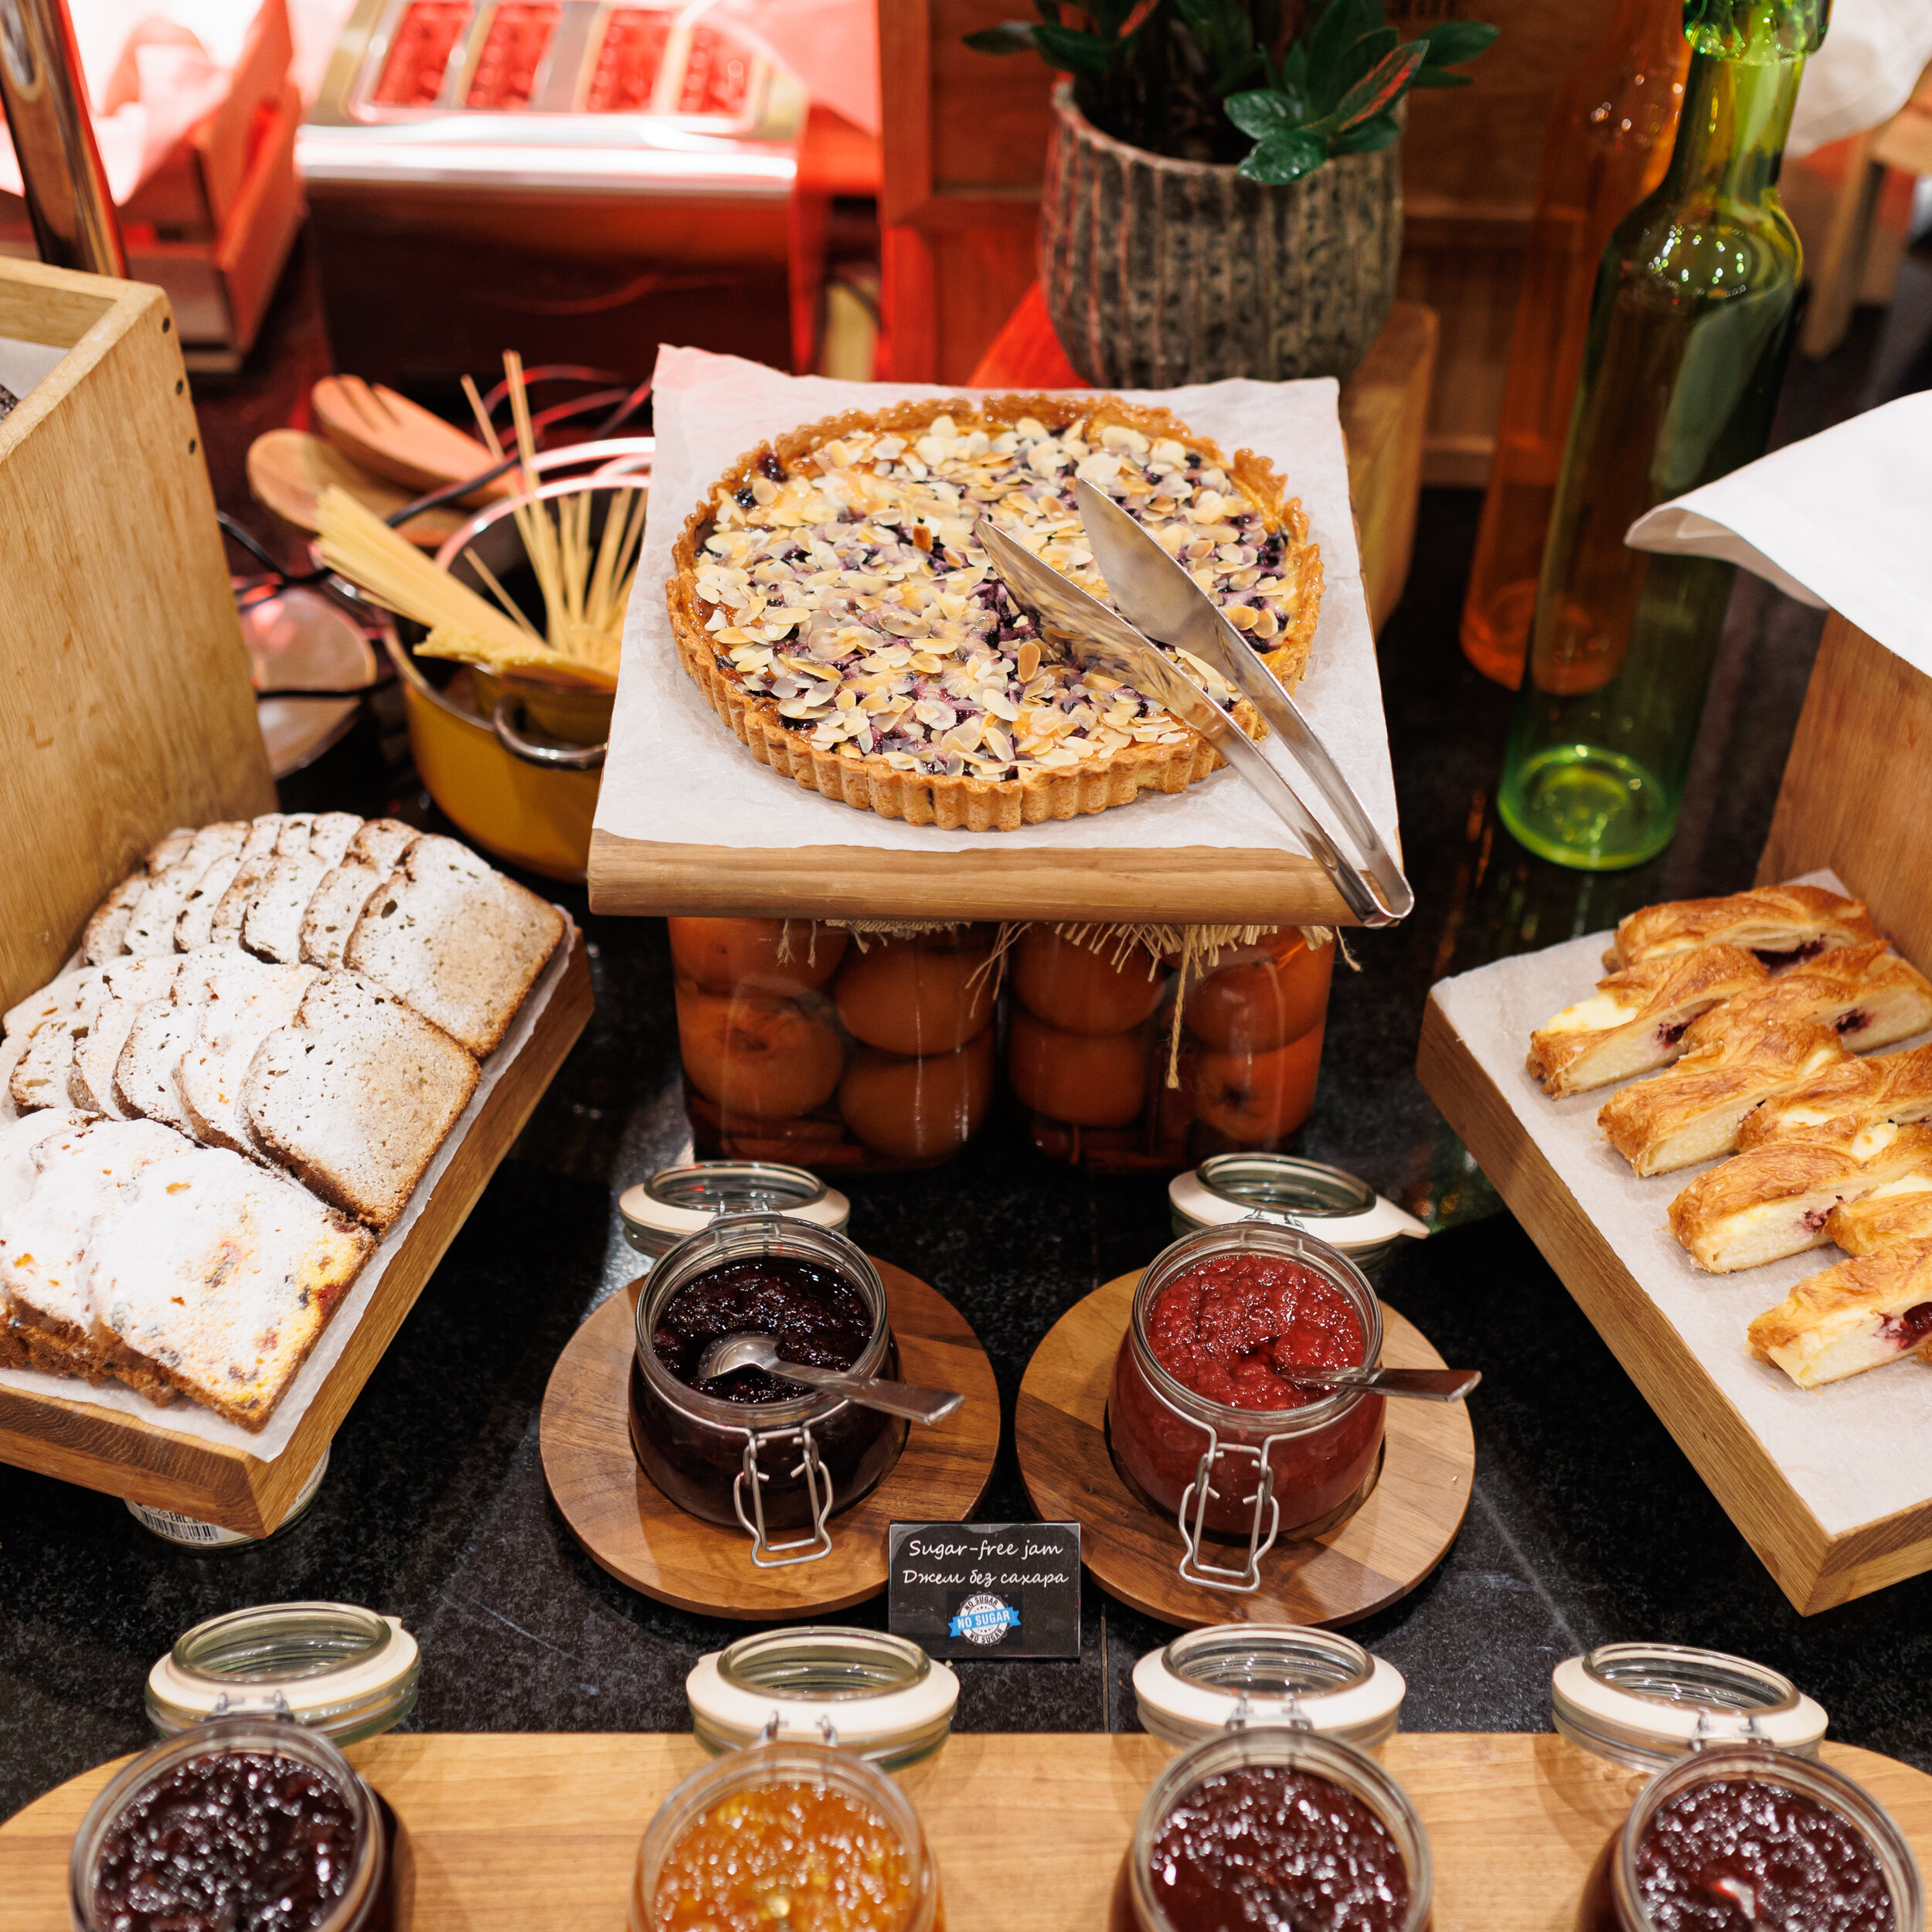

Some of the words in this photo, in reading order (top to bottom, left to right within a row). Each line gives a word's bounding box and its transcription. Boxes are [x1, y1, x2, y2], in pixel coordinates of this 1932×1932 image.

[909, 1539, 1019, 1560] Sugar-free
[1021, 1539, 1064, 1560] jam
[903, 1570, 966, 1584] Джем
[969, 1569, 997, 1587] без
[1001, 1572, 1070, 1587] сахара
[964, 1601, 974, 1611] NO
[975, 1595, 998, 1607] SUGAR
[957, 1616, 972, 1629] NO
[975, 1610, 1010, 1626] SUGAR
[969, 1633, 979, 1641] NO
[981, 1628, 1004, 1644] SUGAR
